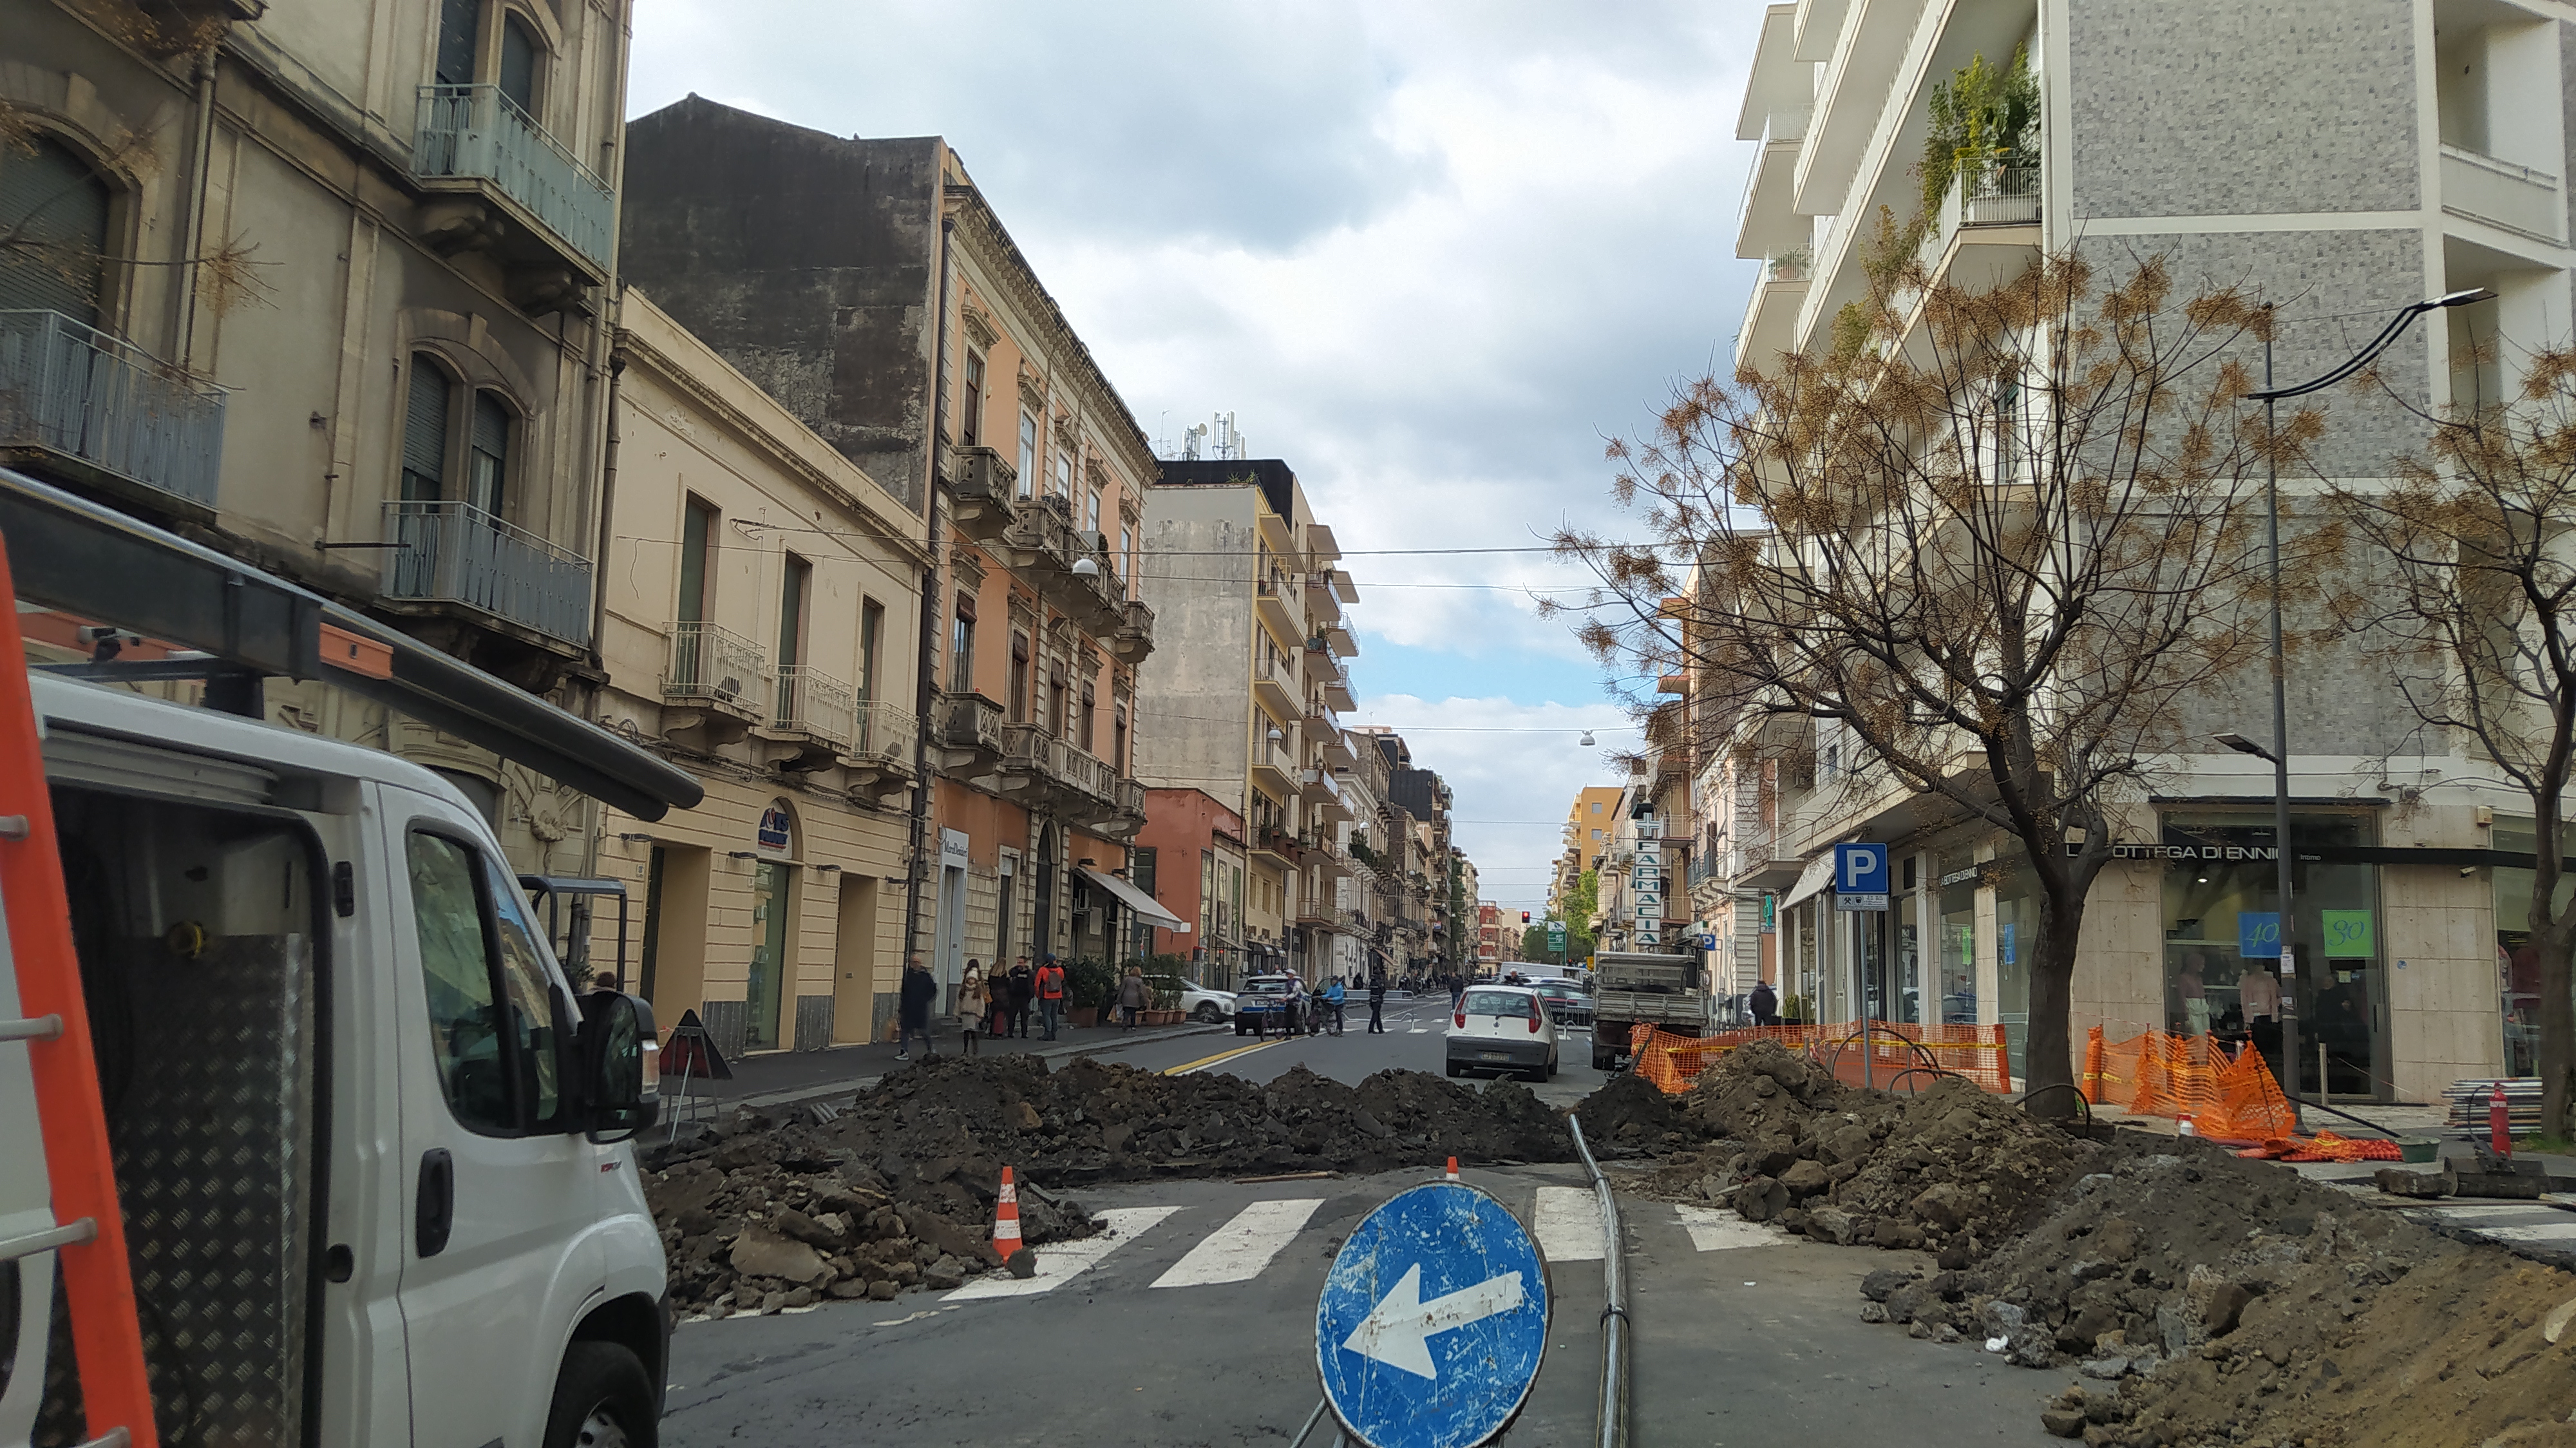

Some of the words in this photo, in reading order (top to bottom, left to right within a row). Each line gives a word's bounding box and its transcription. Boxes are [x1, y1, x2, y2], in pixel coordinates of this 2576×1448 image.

[2112, 845, 2199, 859] OTTEGA
[2202, 846, 2222, 859] DI
[2226, 846, 2279, 860] ENNI
[1846, 850, 1877, 887] P
[1638, 841, 1659, 943] FARMACIA
[1702, 935, 1713, 948] P
[2246, 922, 2280, 948] 40
[2329, 920, 2365, 946] 30
